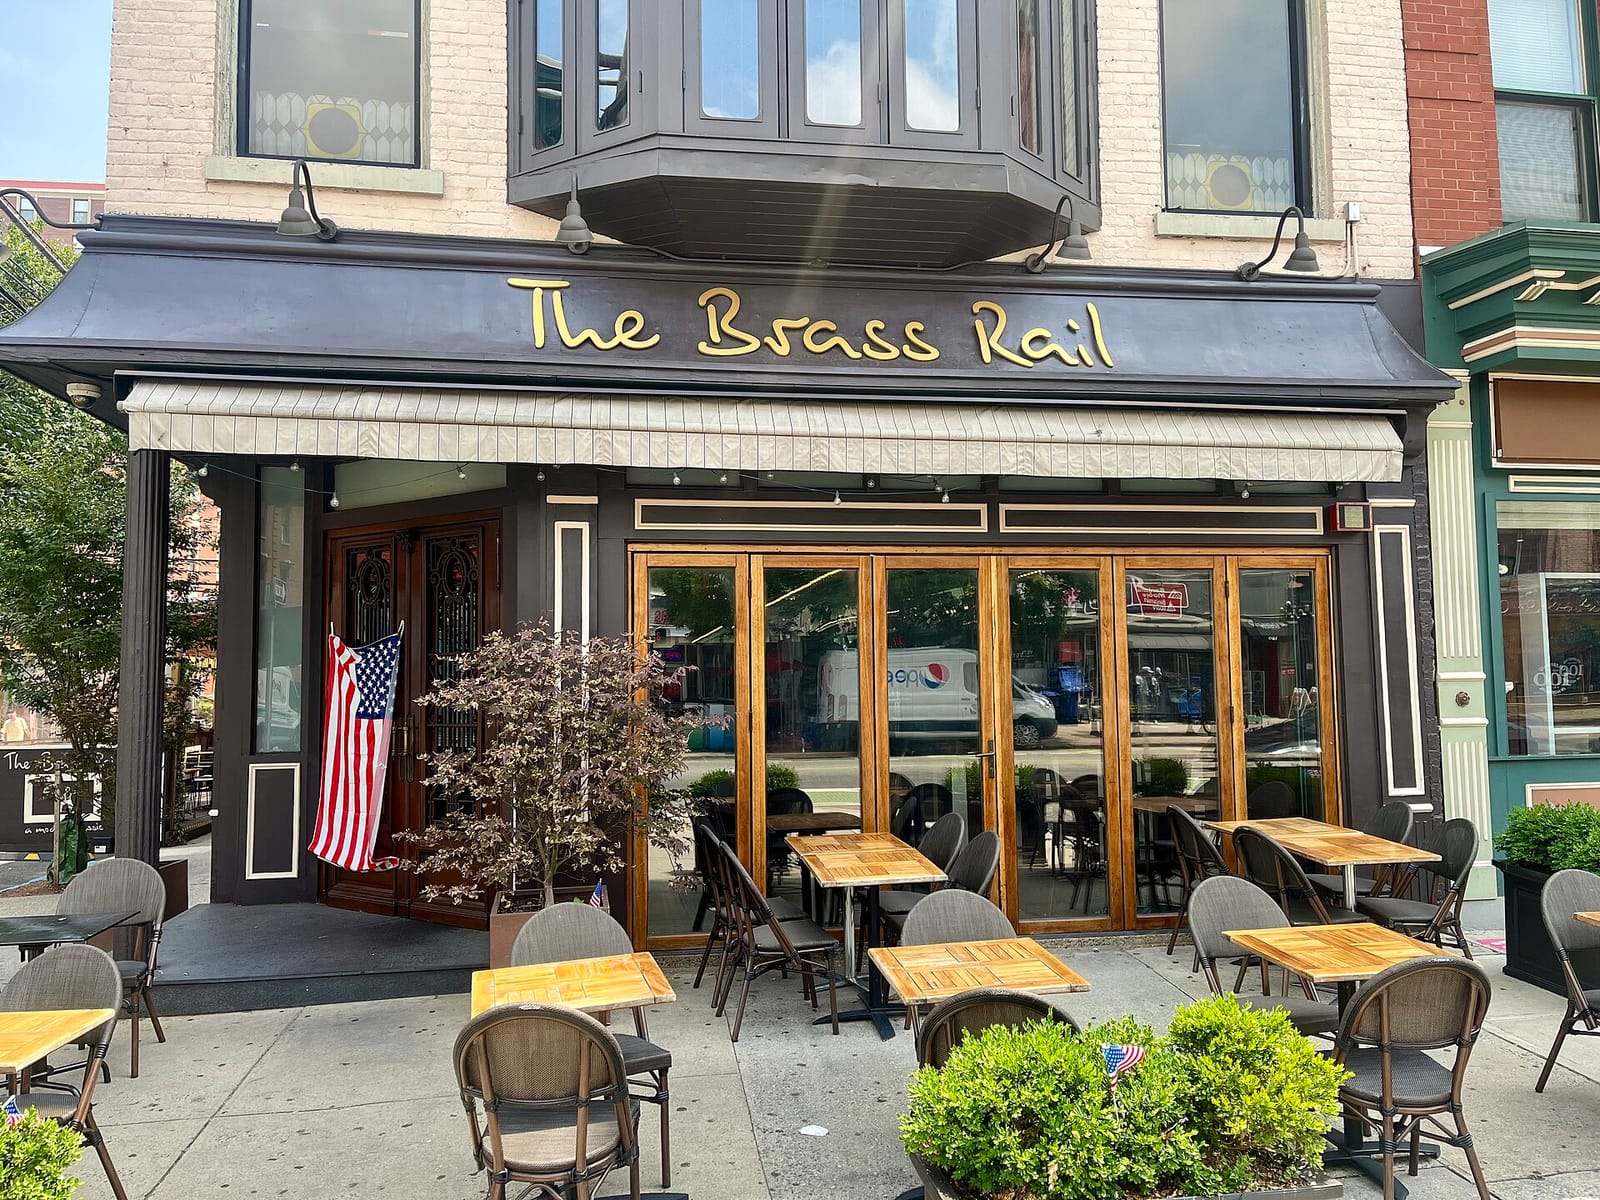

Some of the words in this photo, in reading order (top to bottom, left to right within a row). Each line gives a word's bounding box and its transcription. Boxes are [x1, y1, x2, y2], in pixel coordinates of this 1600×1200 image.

[507, 277, 661, 350] The
[698, 287, 940, 361] Brass
[972, 300, 1114, 368] Rail
[3, 751, 31, 770] The
